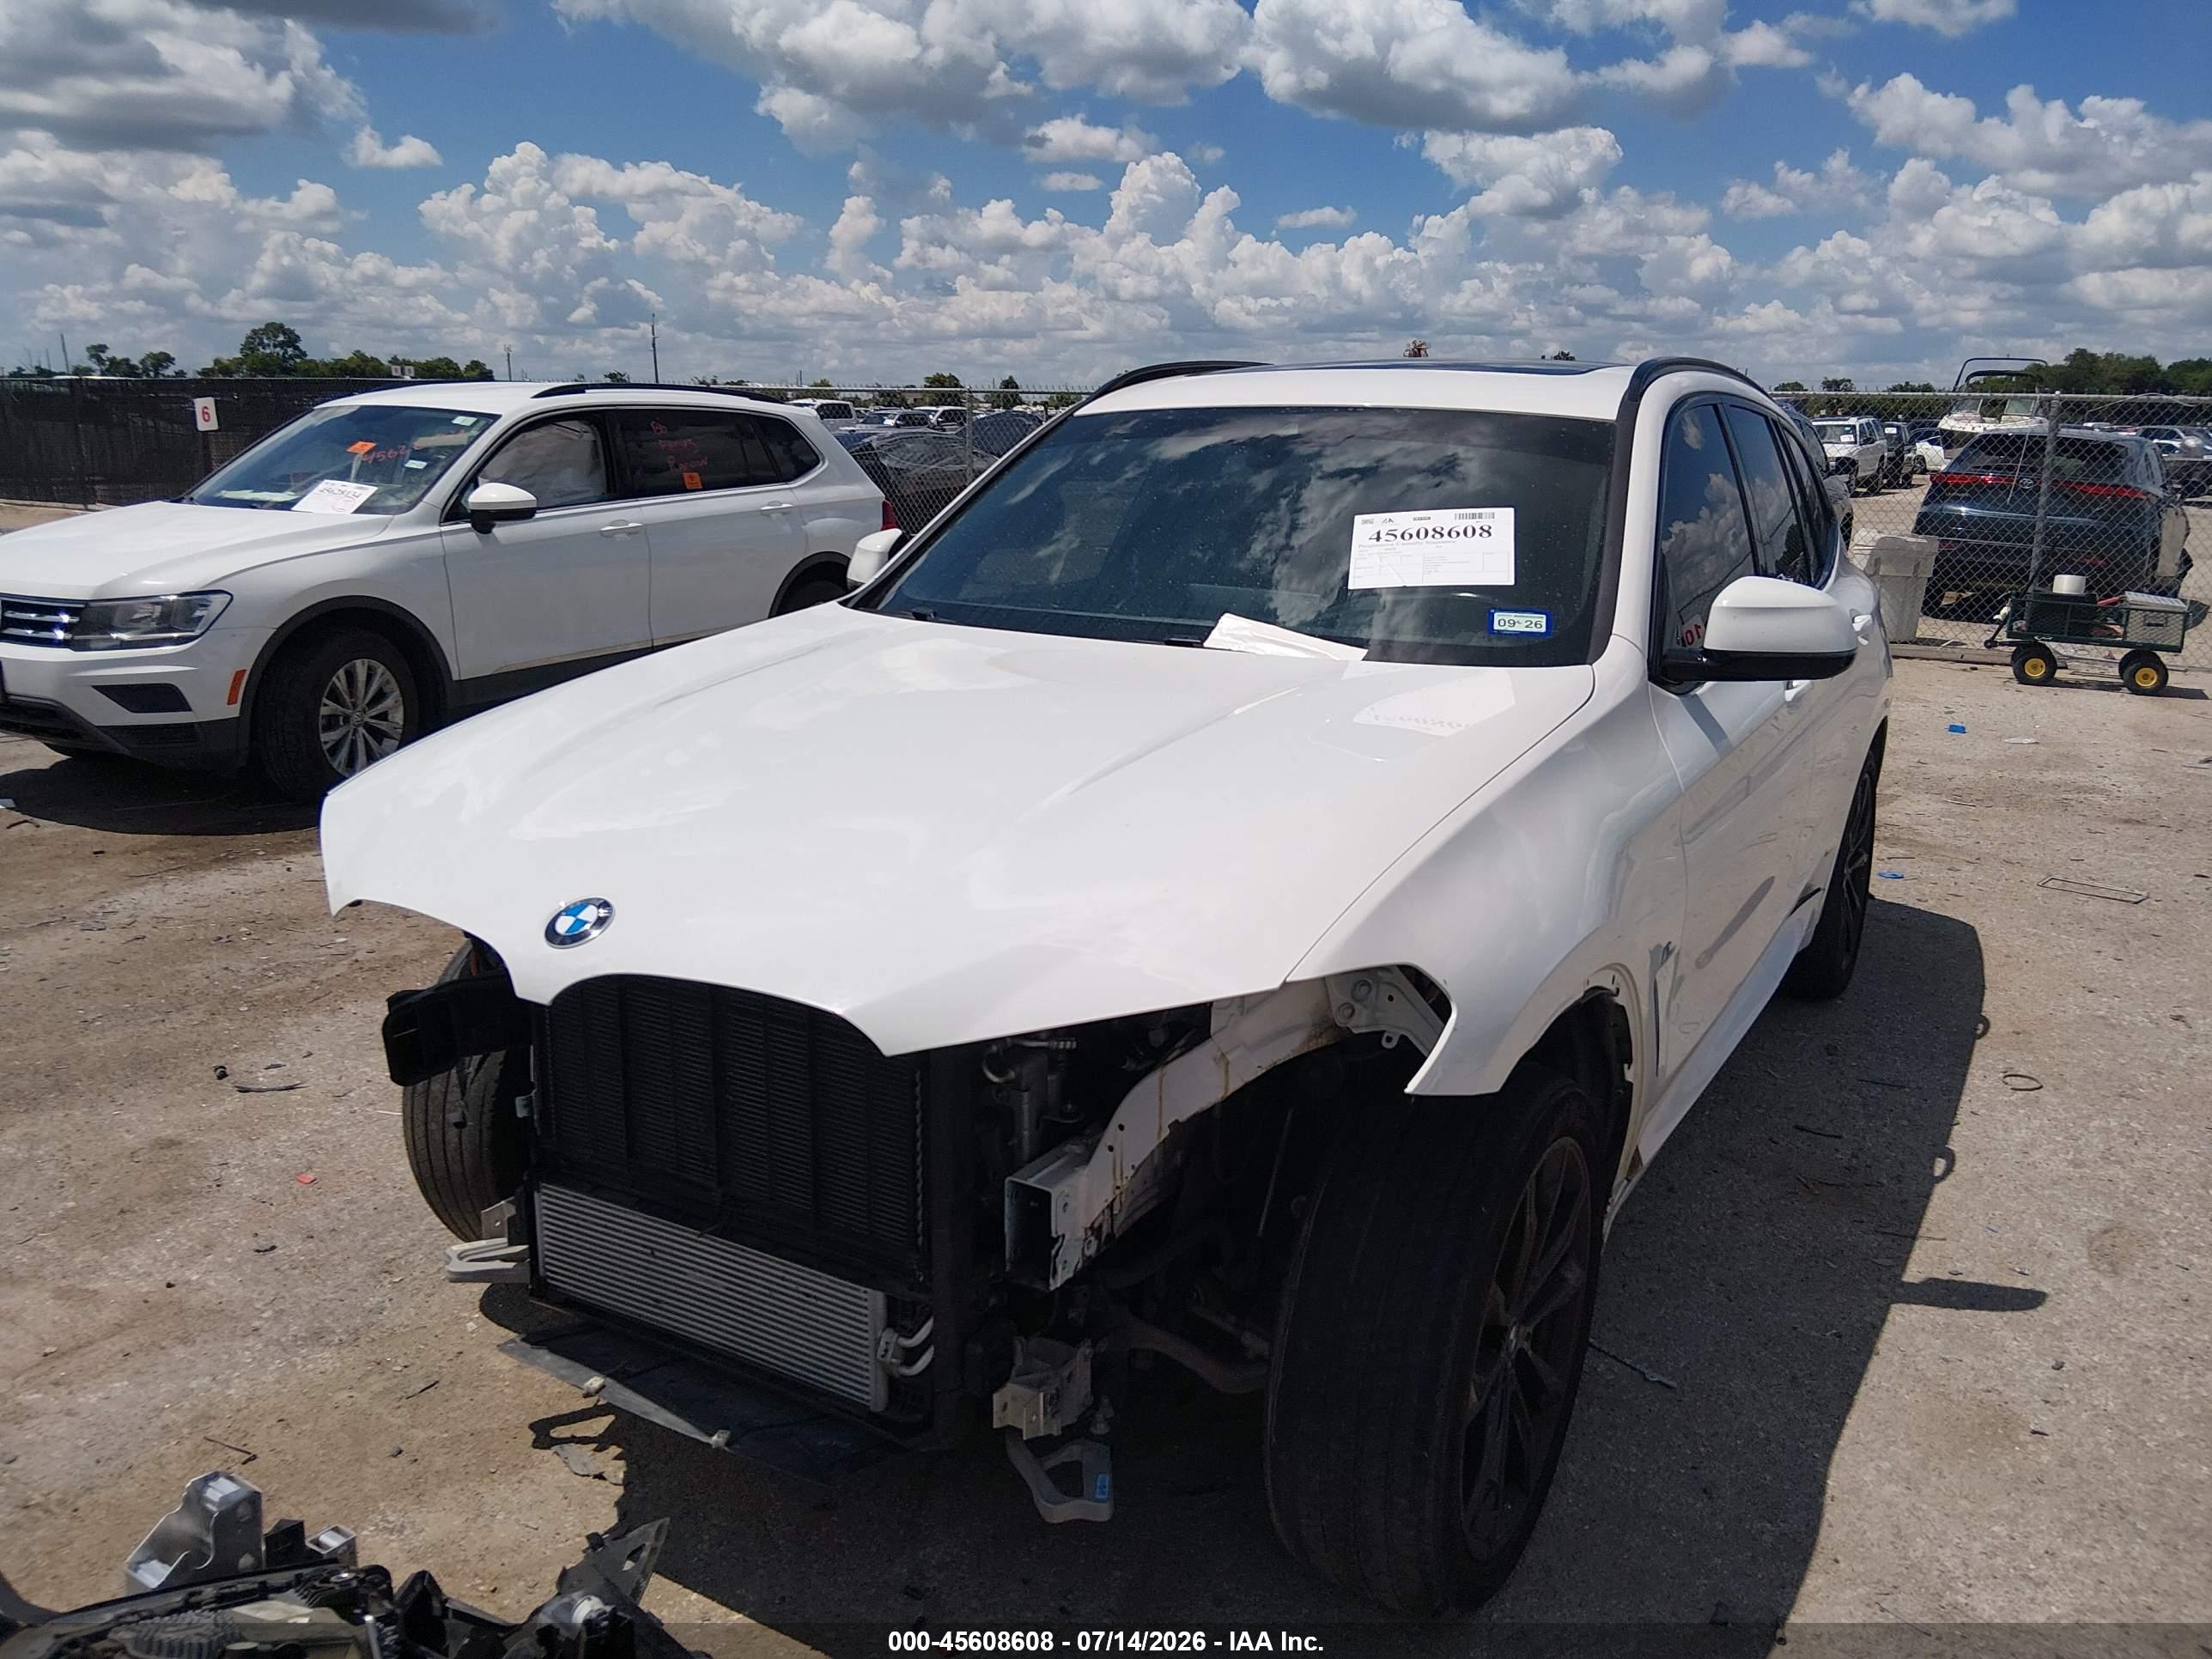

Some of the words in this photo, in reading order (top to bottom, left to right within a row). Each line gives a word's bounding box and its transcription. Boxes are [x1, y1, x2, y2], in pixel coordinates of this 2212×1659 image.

[202, 405, 210, 422] 6
[1368, 525, 1492, 543] 45608608
[1498, 618, 1516, 628] 09
[1524, 620, 1543, 629] 26
